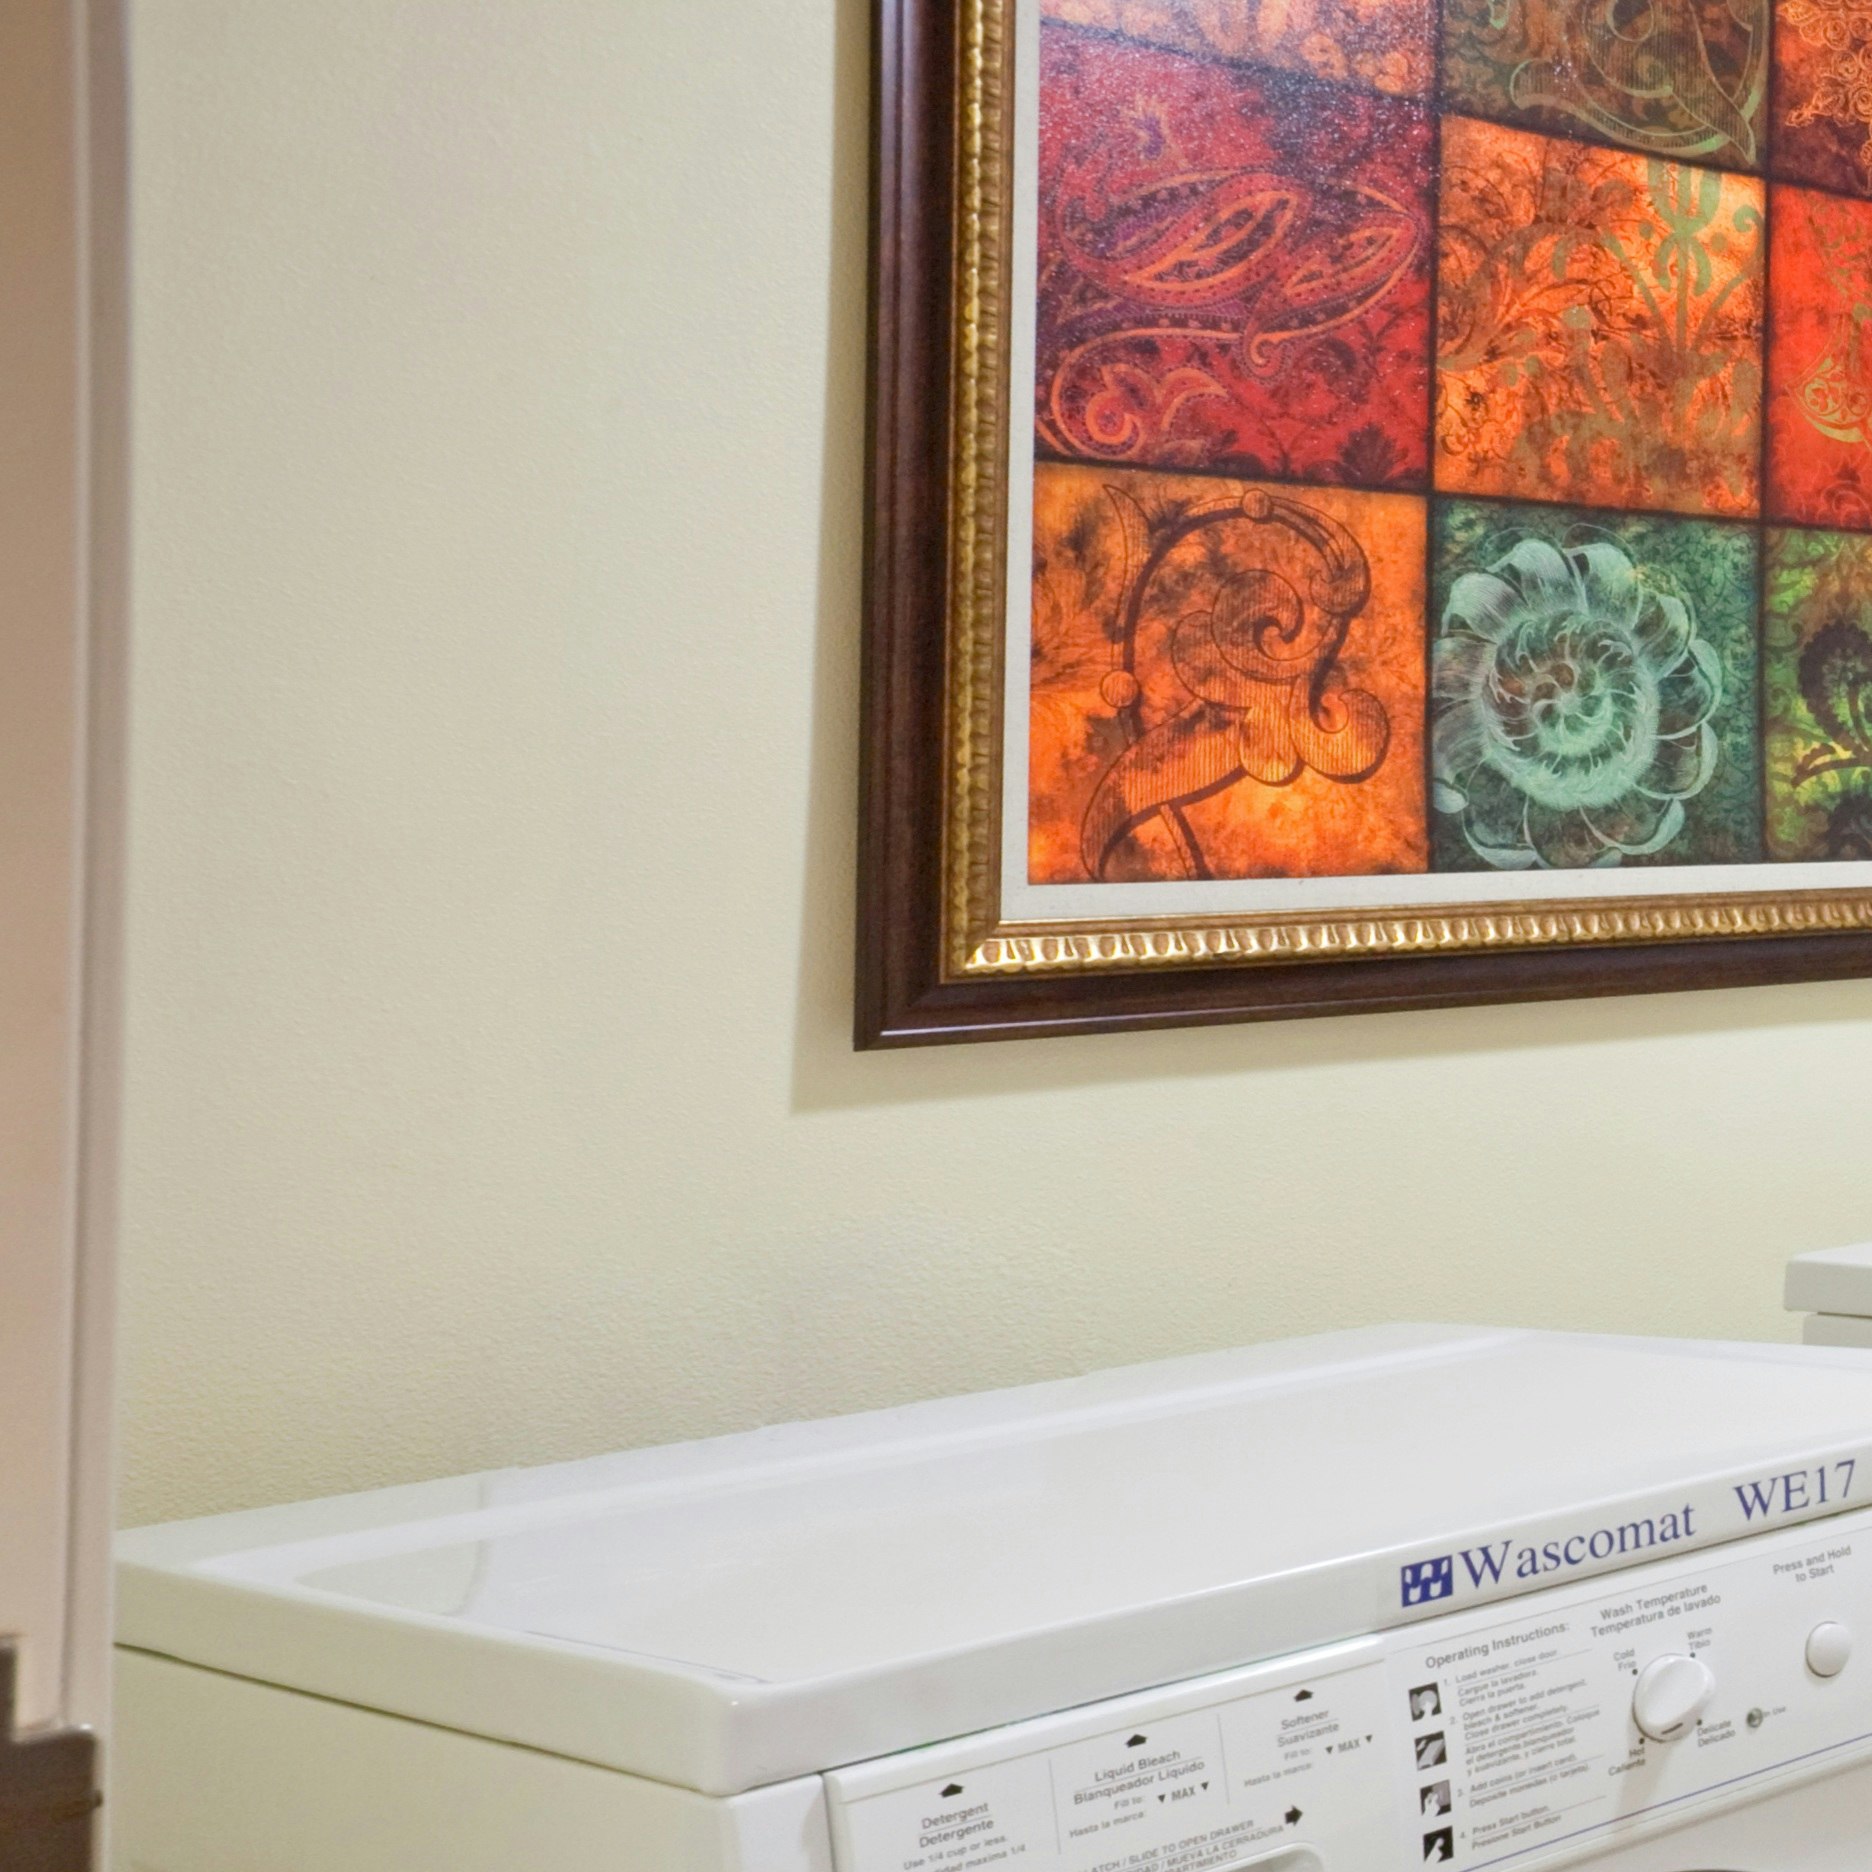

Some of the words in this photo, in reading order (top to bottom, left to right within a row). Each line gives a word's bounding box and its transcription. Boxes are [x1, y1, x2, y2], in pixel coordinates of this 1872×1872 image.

[1458, 1502, 1697, 1589] Wascomat
[1732, 1458, 1857, 1521] WE17
[1772, 1560, 1803, 1575] Press
[1806, 1552, 1825, 1566] and
[1827, 1545, 1852, 1560] Hold
[1795, 1573, 1807, 1582] to
[1809, 1564, 1835, 1579] Start
[1590, 1610, 1664, 1638] Temperatura
[1667, 1605, 1681, 1617] de
[1684, 1595, 1721, 1612] lavado
[1600, 1603, 1633, 1621] Wash
[1636, 1584, 1708, 1610] Temperature
[1425, 1643, 1490, 1669] Operating
[1492, 1622, 1570, 1651] Instructions:
[1613, 1648, 1635, 1661] Cold
[1281, 1710, 1329, 1730] Softener
[1277, 1723, 1339, 1747] Suavizante
[1337, 1739, 1360, 1752] MAX
[1698, 1729, 1736, 1748] Delicado
[1094, 1762, 1135, 1783] Liquid
[1138, 1750, 1181, 1769] Bleach
[1073, 1774, 1154, 1805] Blanqueador
[1171, 1786, 1196, 1801] MAX
[921, 1802, 989, 1830] Detergent
[1101, 1820, 1110, 1829] la
[919, 1819, 994, 1848] Detergente
[1128, 1848, 1159, 1865] SLIDE
[1161, 1841, 1176, 1853] TO
[1179, 1832, 1208, 1849] OPEN
[1210, 1819, 1254, 1841] DRAWER
[1166, 1849, 1203, 1867] MUEVA
[1205, 1844, 1219, 1857] LA
[1222, 1825, 1284, 1852] CERRADURA
[903, 1858, 925, 1870] Use
[947, 1846, 967, 1860] cup
[970, 1842, 981, 1851] or
[1011, 1844, 1026, 1855] 1/4
